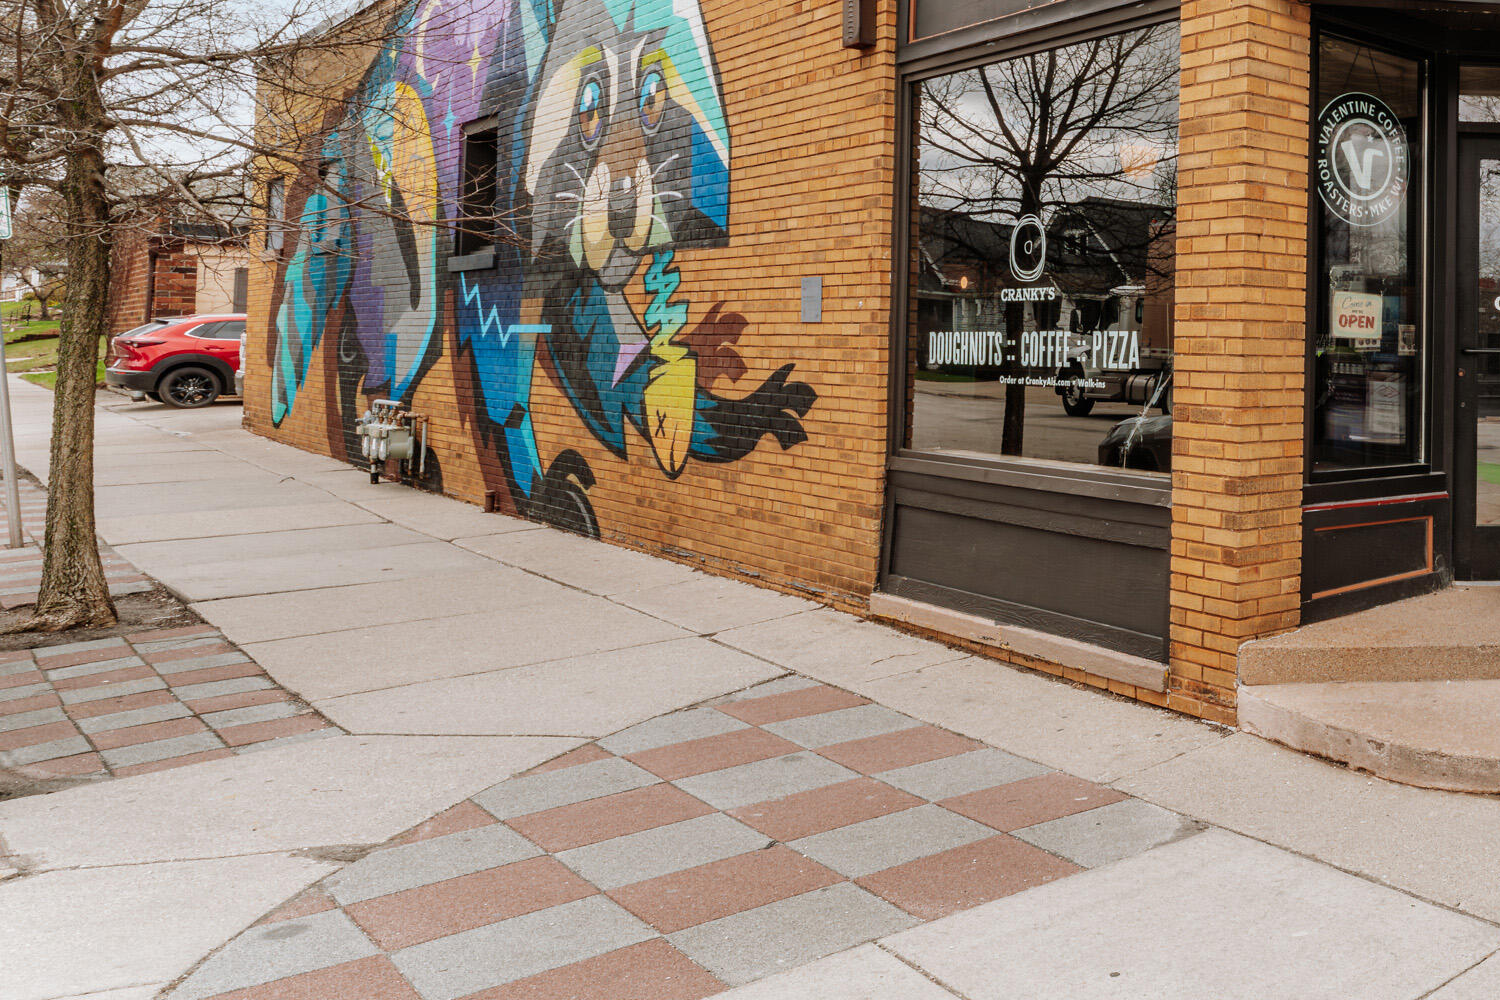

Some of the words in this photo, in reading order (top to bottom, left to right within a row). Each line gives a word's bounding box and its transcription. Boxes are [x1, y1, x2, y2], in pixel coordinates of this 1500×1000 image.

[1318, 101, 1376, 145] VALENTINE
[1378, 111, 1404, 163] COFFEE
[1318, 159, 1363, 218] ROASTERS
[1369, 197, 1393, 218] MKE
[1001, 287, 1056, 302] CRANKY'S
[1338, 314, 1375, 329] OPEN
[929, 331, 1002, 366] DOUGHNUTS
[1021, 331, 1071, 367] COFFEE
[1092, 331, 1140, 369] PIZZA
[999, 375, 1016, 385] Order
[1018, 376, 1024, 385] at
[1078, 378, 1106, 388] Walk-ins
